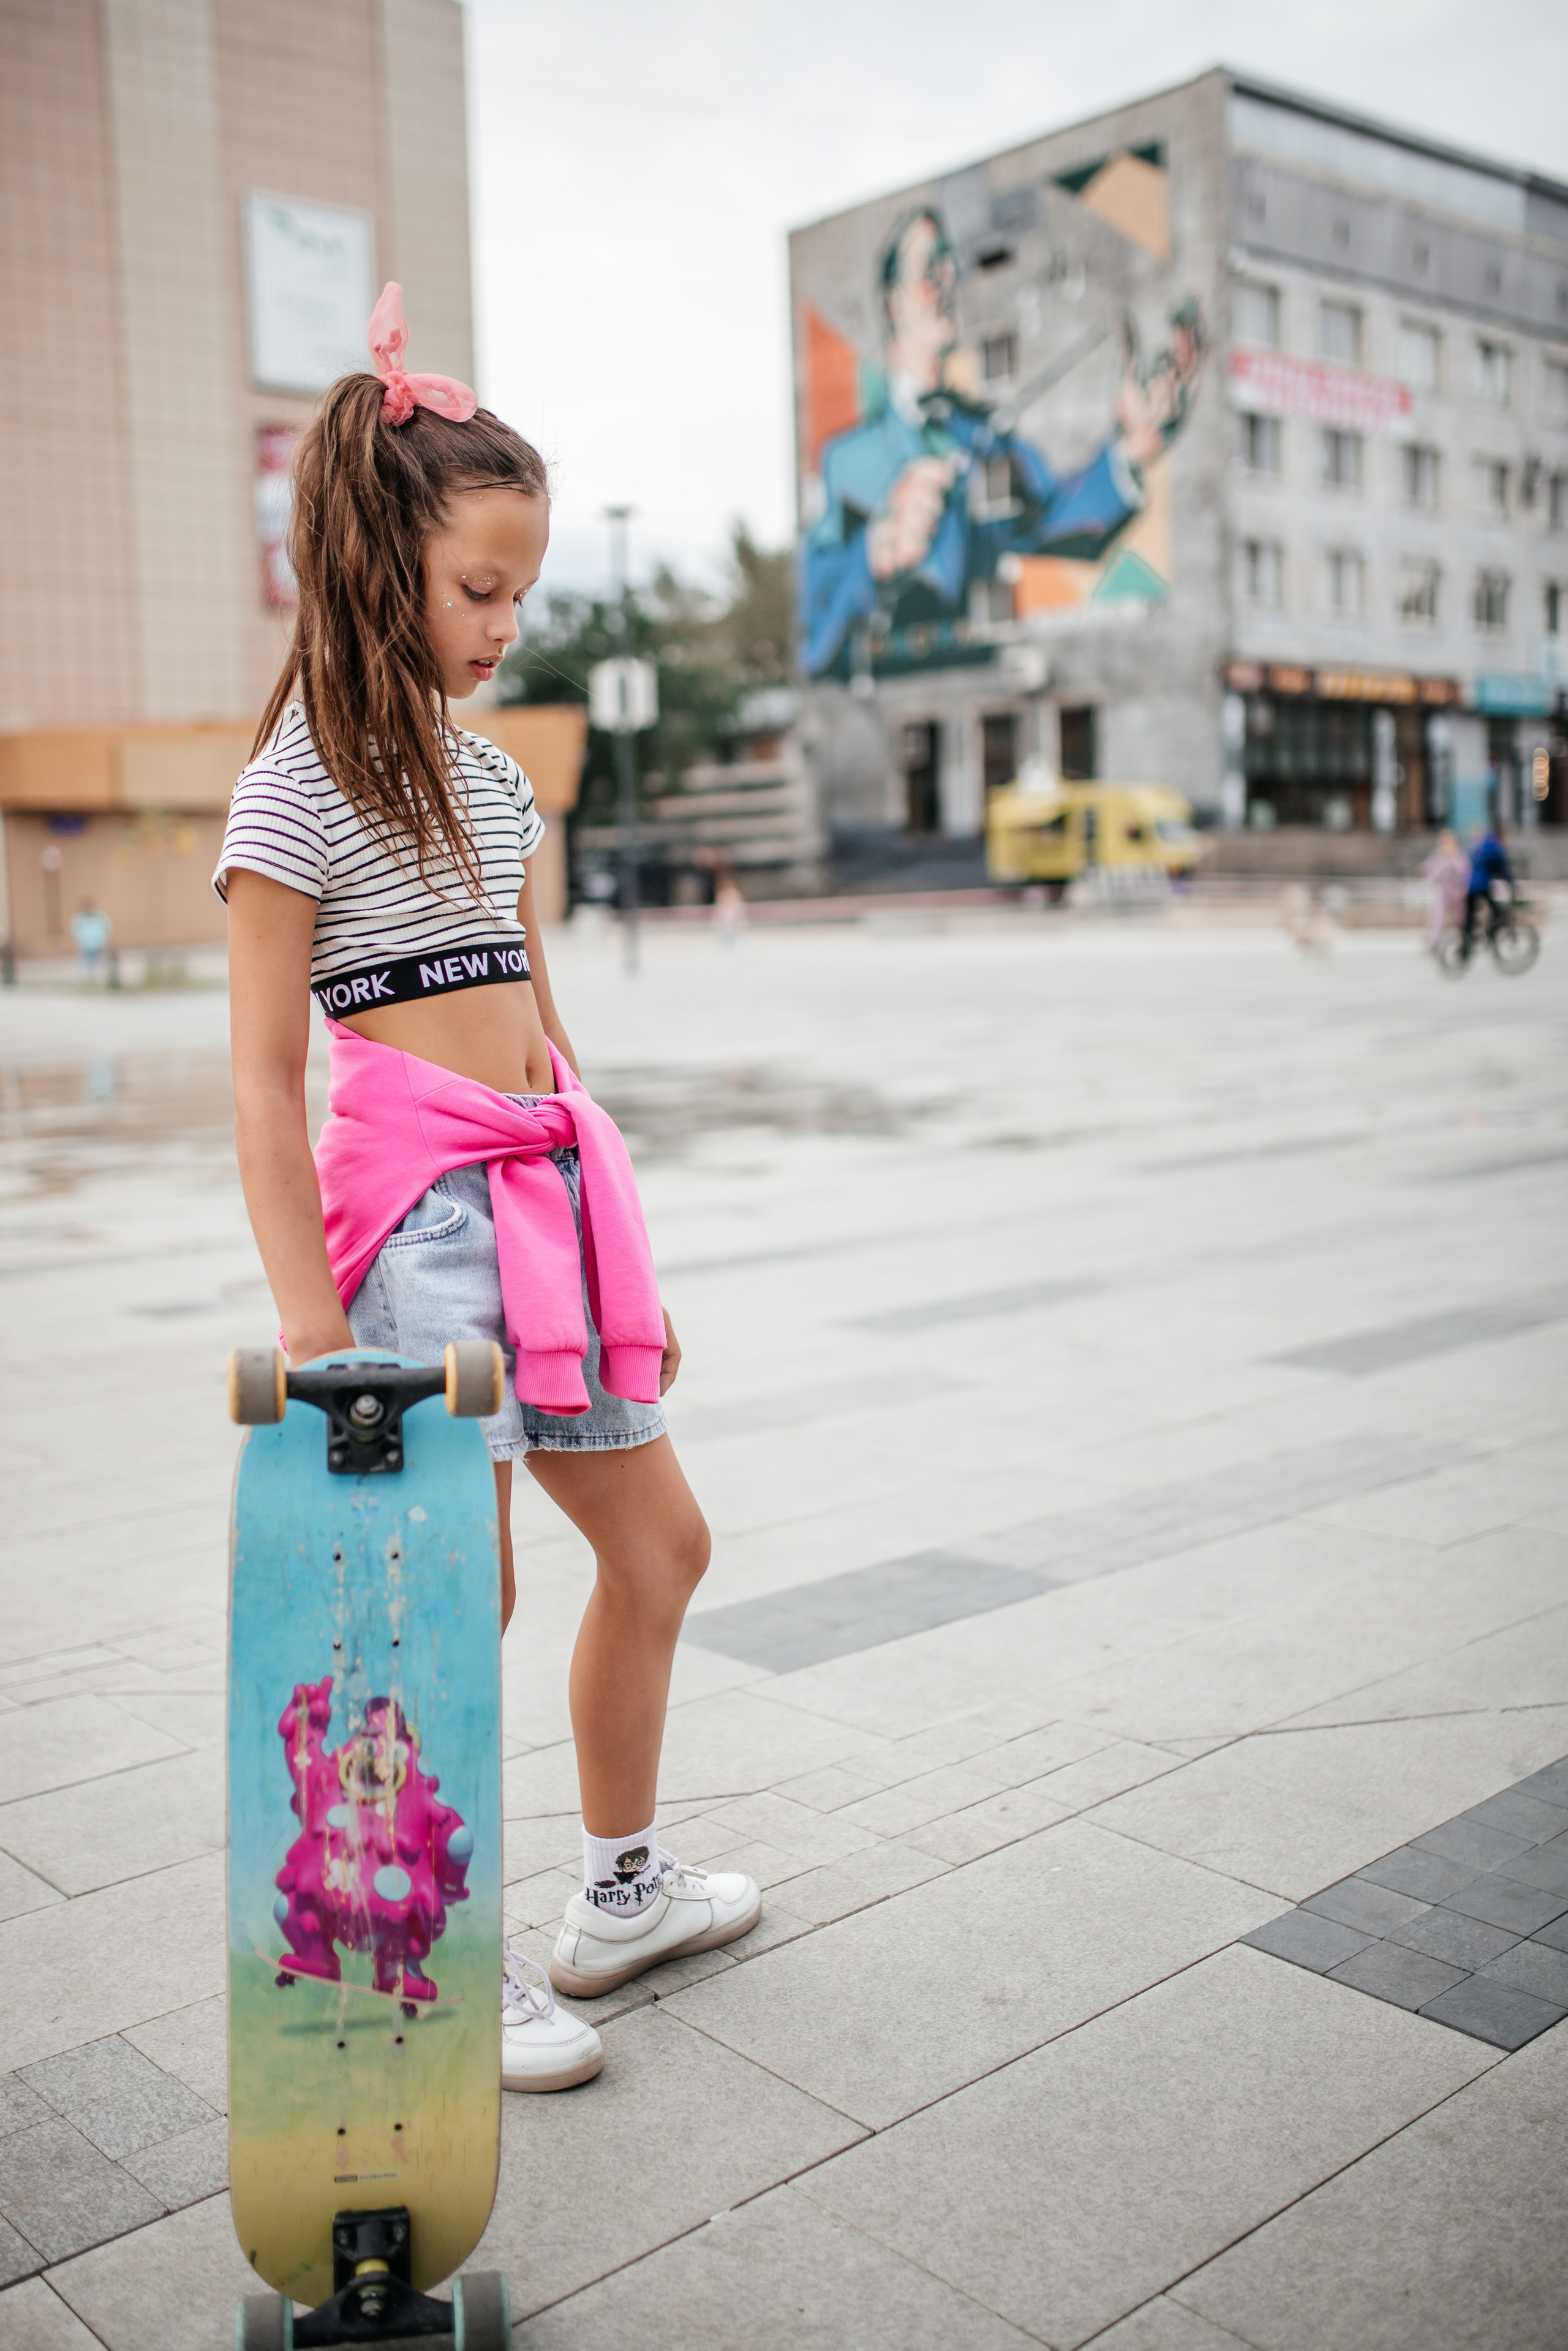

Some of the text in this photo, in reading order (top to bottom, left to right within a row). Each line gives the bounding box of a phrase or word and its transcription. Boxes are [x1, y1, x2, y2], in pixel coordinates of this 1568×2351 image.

[320, 971, 395, 1012] YORK
[418, 952, 488, 988] NEW
[585, 1886, 631, 1908] Harry
